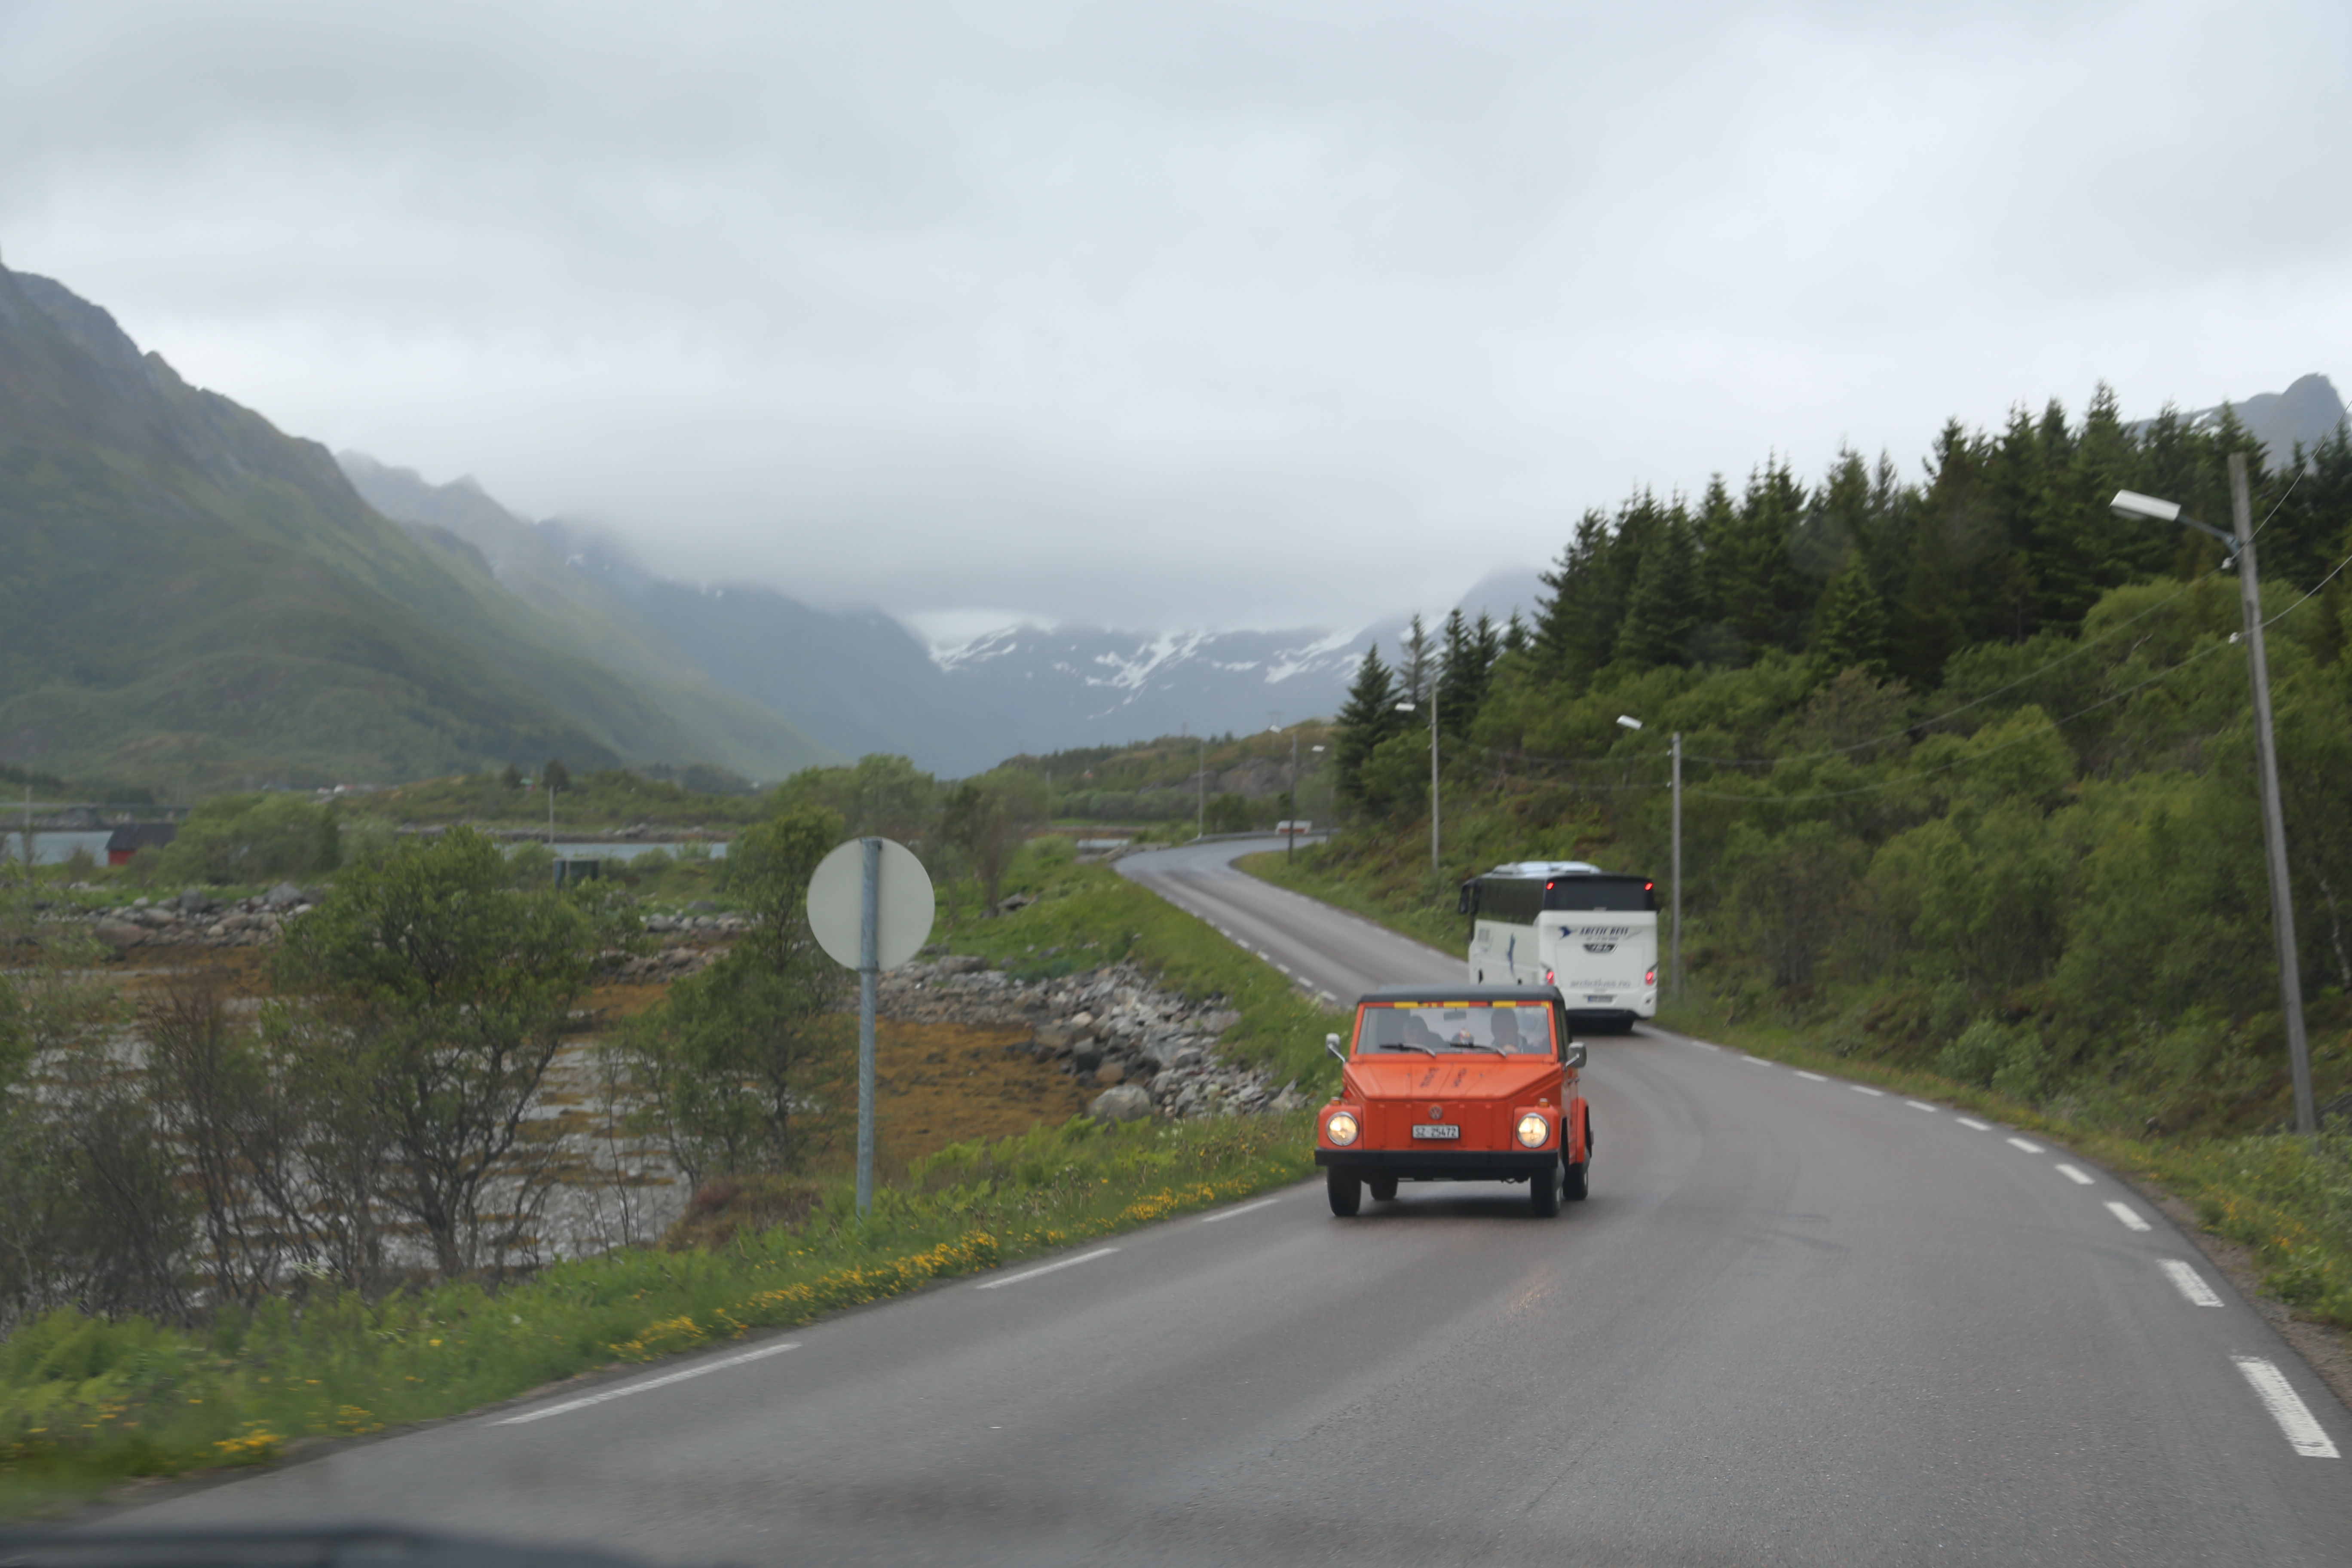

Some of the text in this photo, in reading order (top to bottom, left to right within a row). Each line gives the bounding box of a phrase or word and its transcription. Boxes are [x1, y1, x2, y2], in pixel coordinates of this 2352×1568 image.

[1580, 927, 1608, 935] ARCTIC
[1415, 1126, 1457, 1138] SZ 25472
